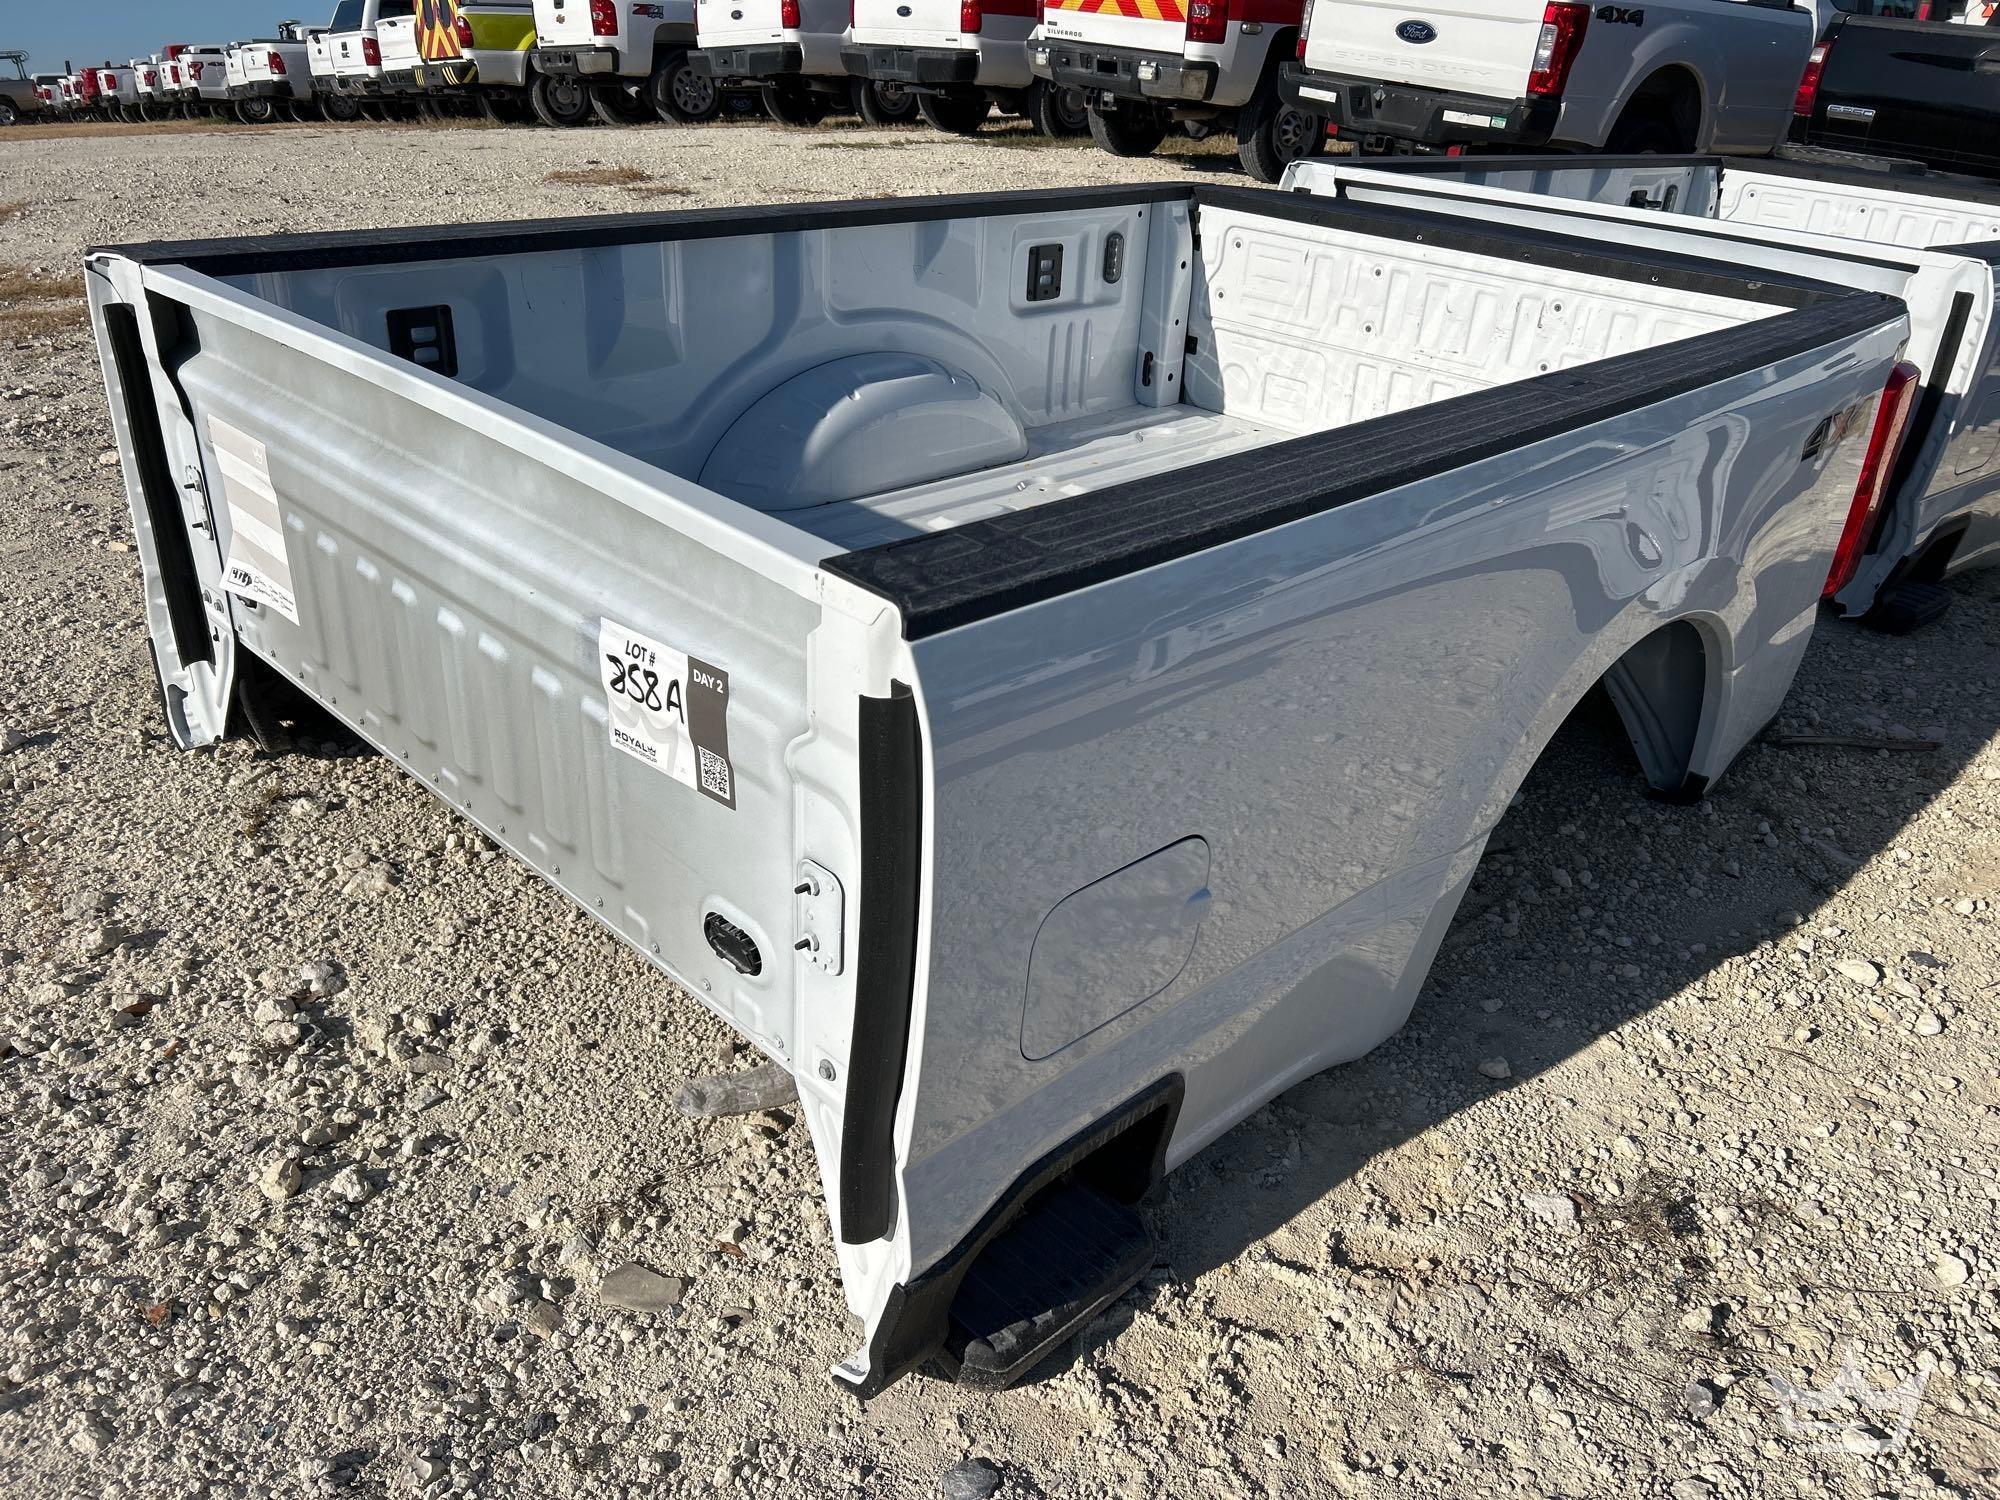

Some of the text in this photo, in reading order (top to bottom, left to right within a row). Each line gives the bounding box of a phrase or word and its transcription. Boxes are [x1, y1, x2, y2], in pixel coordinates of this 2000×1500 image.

[1047, 28, 1083, 37] SILVERADO
[1335, 49, 1494, 79] SUPER DUTY
[625, 640, 647, 663] LOT
[606, 653, 685, 724] 258A
[693, 668, 724, 694] DAY 2
[614, 728, 648, 753] ROYAL
[615, 738, 657, 764] AUCTION GROUP
